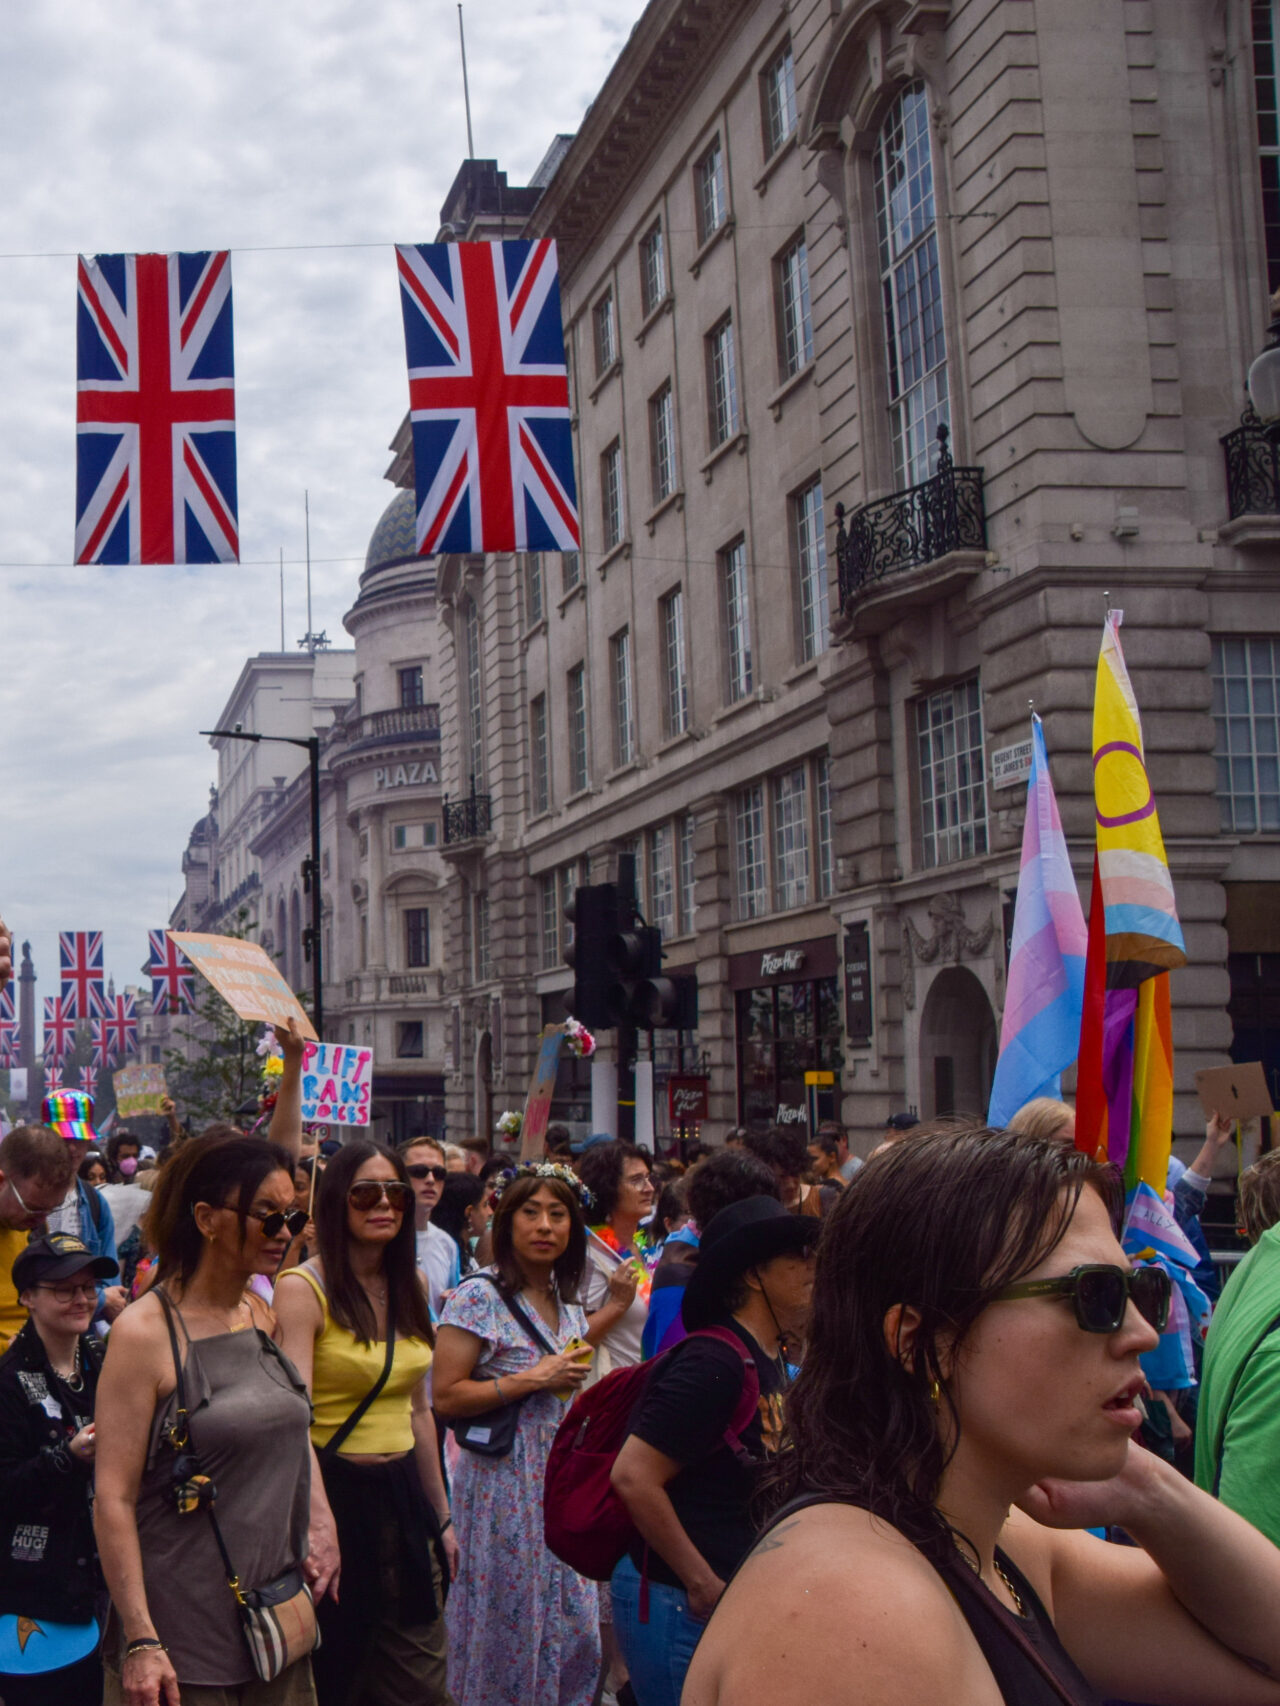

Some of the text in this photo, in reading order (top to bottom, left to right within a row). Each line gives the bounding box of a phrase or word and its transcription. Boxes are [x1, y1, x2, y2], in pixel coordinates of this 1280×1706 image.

[373, 761, 438, 791] PLAZA
[302, 1041, 371, 1083] PLIFT
[303, 1075, 369, 1104] RANS
[674, 1088, 703, 1100] Pizza
[301, 1103, 368, 1125] VOICES
[797, 1103, 807, 1122] Hu
[1144, 1208, 1174, 1229] ALLY
[15, 1524, 49, 1538] FREE
[11, 1535, 47, 1549] HUG!
